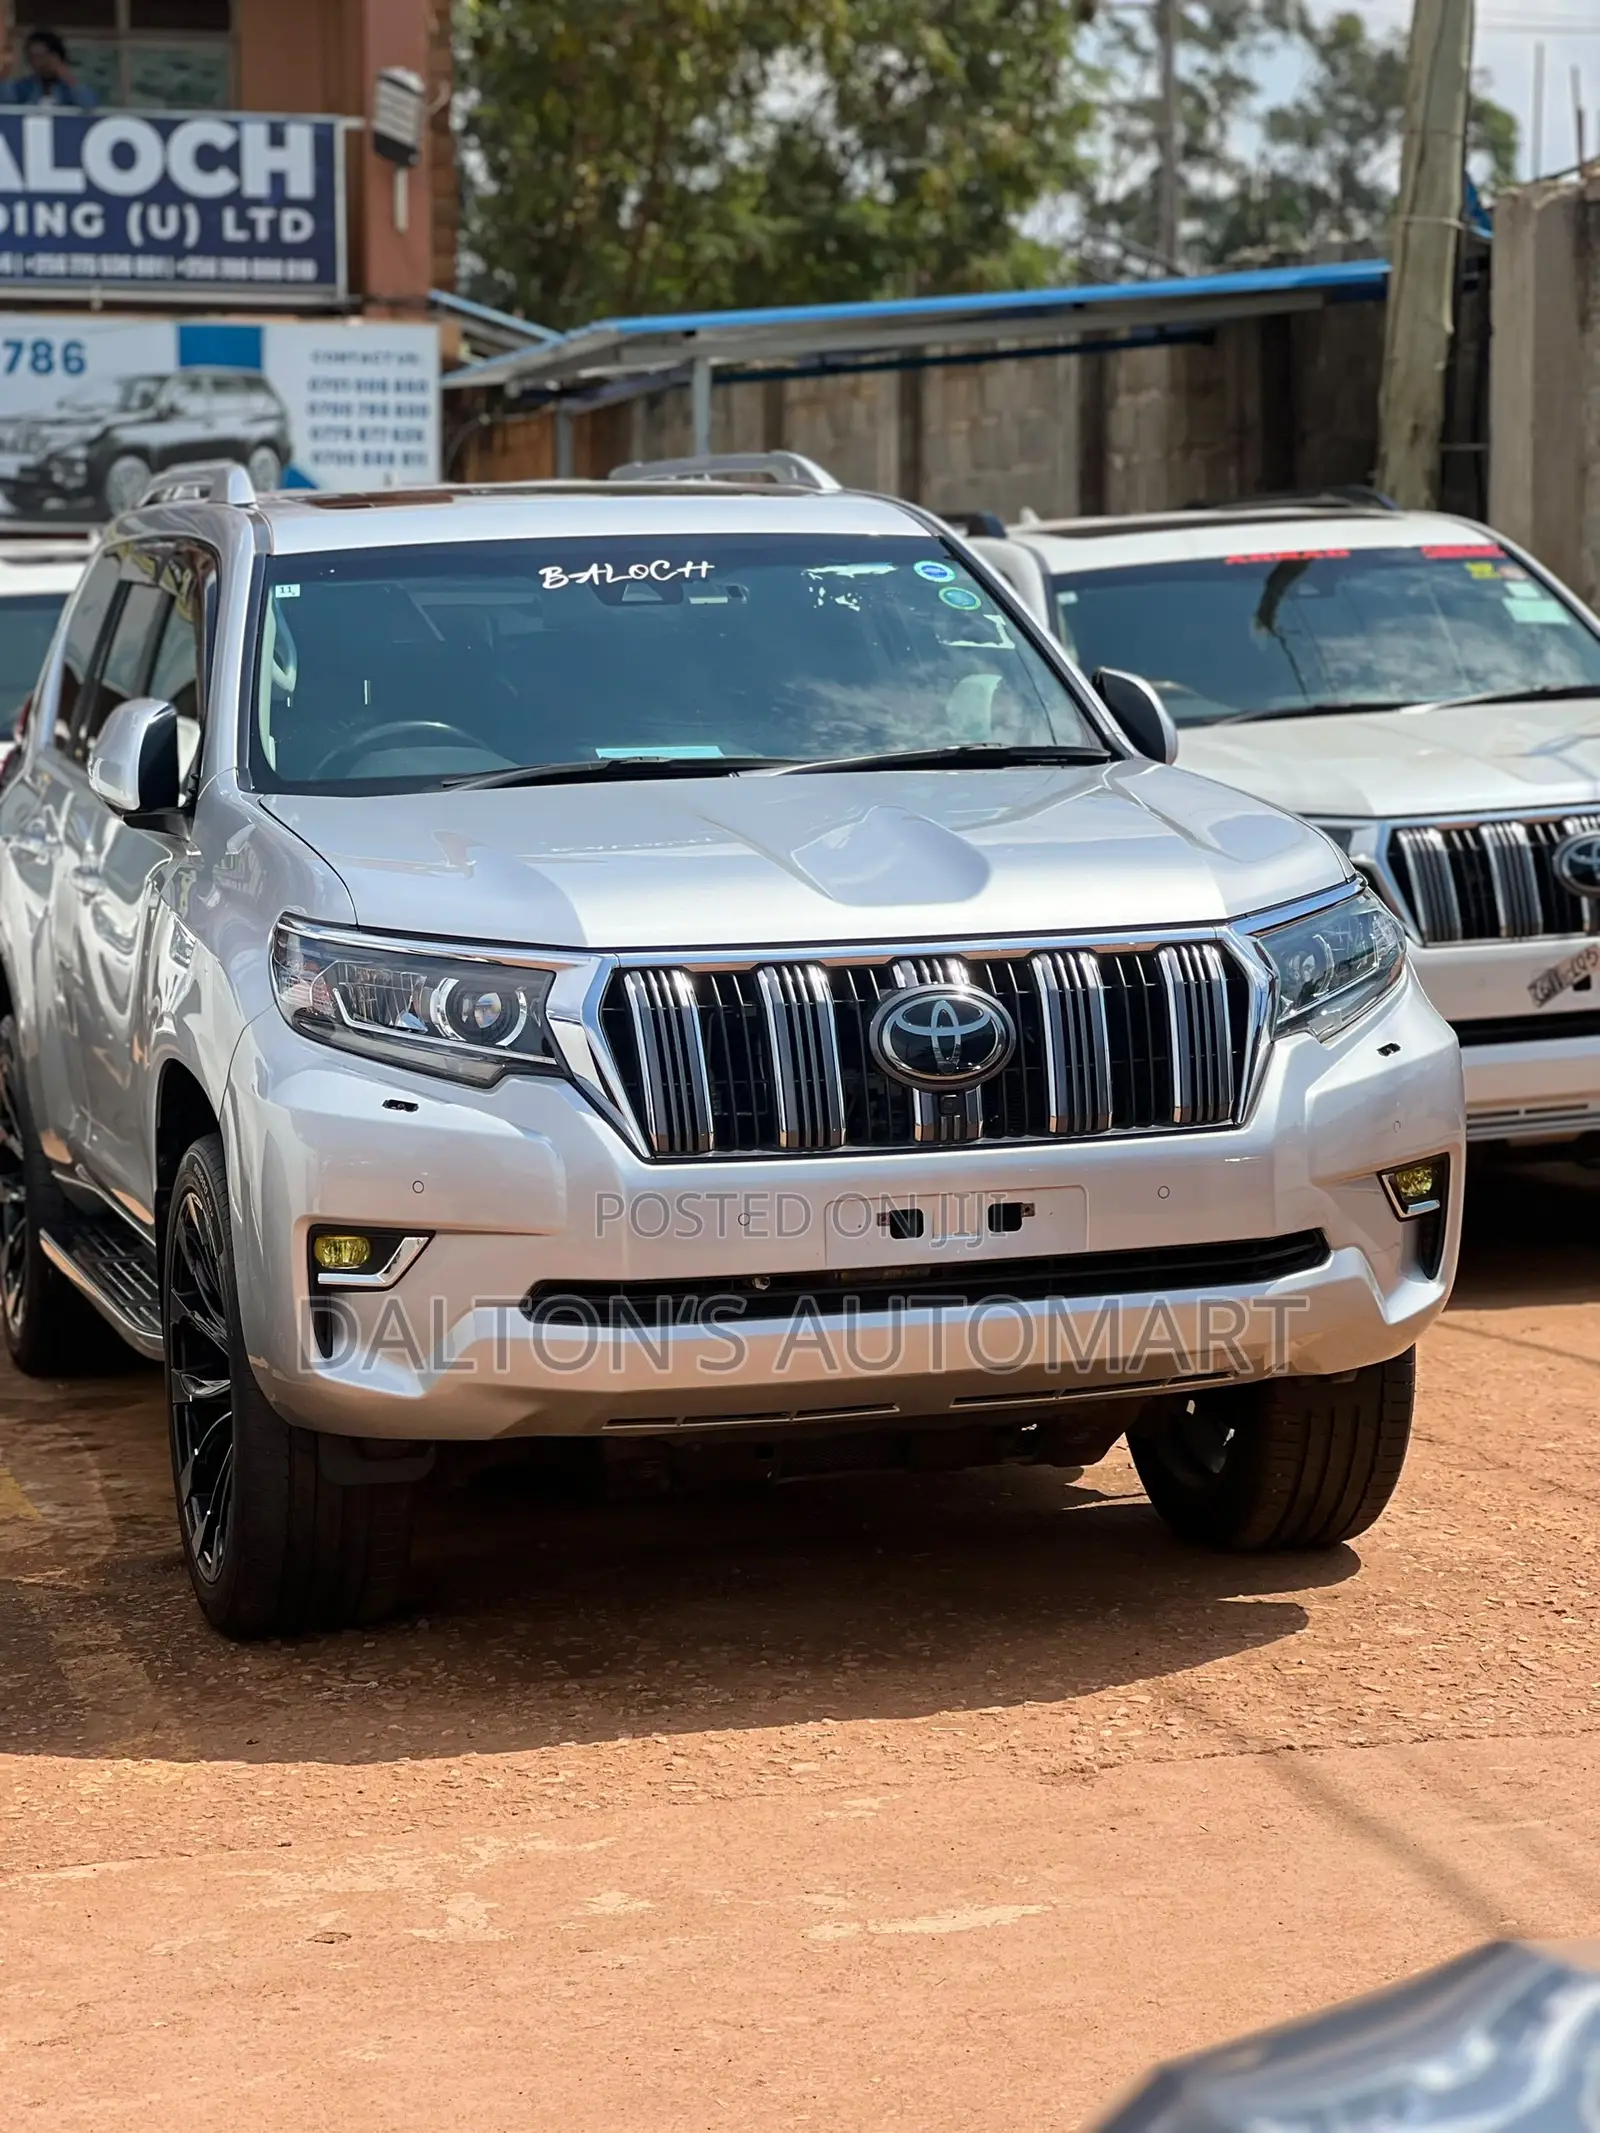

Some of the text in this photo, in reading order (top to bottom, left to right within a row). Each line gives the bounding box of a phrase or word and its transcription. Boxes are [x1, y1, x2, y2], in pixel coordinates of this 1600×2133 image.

[0, 201, 315, 248] ING (U) LTD
[2, 338, 87, 376] 786
[538, 560, 715, 589] BALOCH
